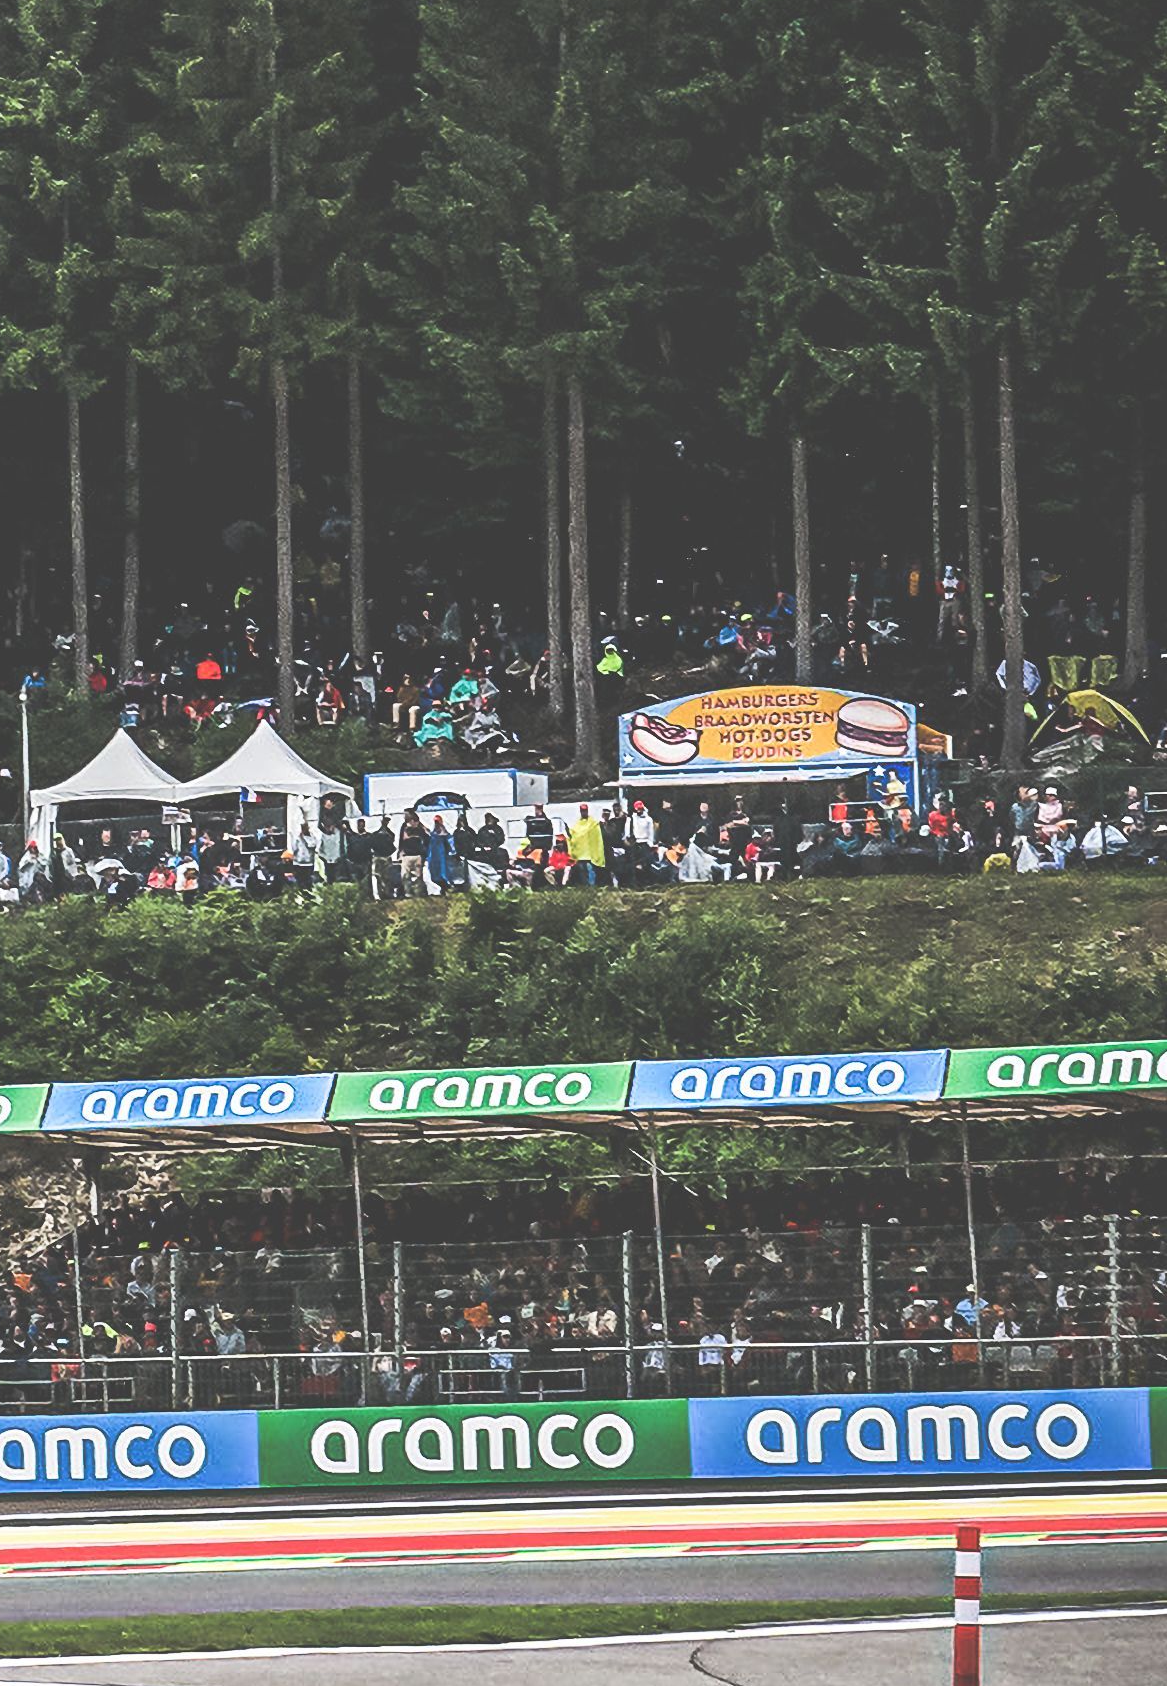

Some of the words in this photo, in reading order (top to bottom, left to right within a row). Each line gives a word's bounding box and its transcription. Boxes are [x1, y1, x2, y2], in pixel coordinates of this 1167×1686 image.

[694, 711, 835, 728] BRAADWORSTEN
[700, 693, 819, 710] HAMBURGERS
[732, 745, 803, 760] BOUDINS
[369, 1072, 592, 1111] aramco
[671, 1061, 905, 1100] aramco
[82, 1082, 294, 1122] aramco
[311, 1412, 635, 1474] aramco
[746, 1402, 1090, 1464] aramco
